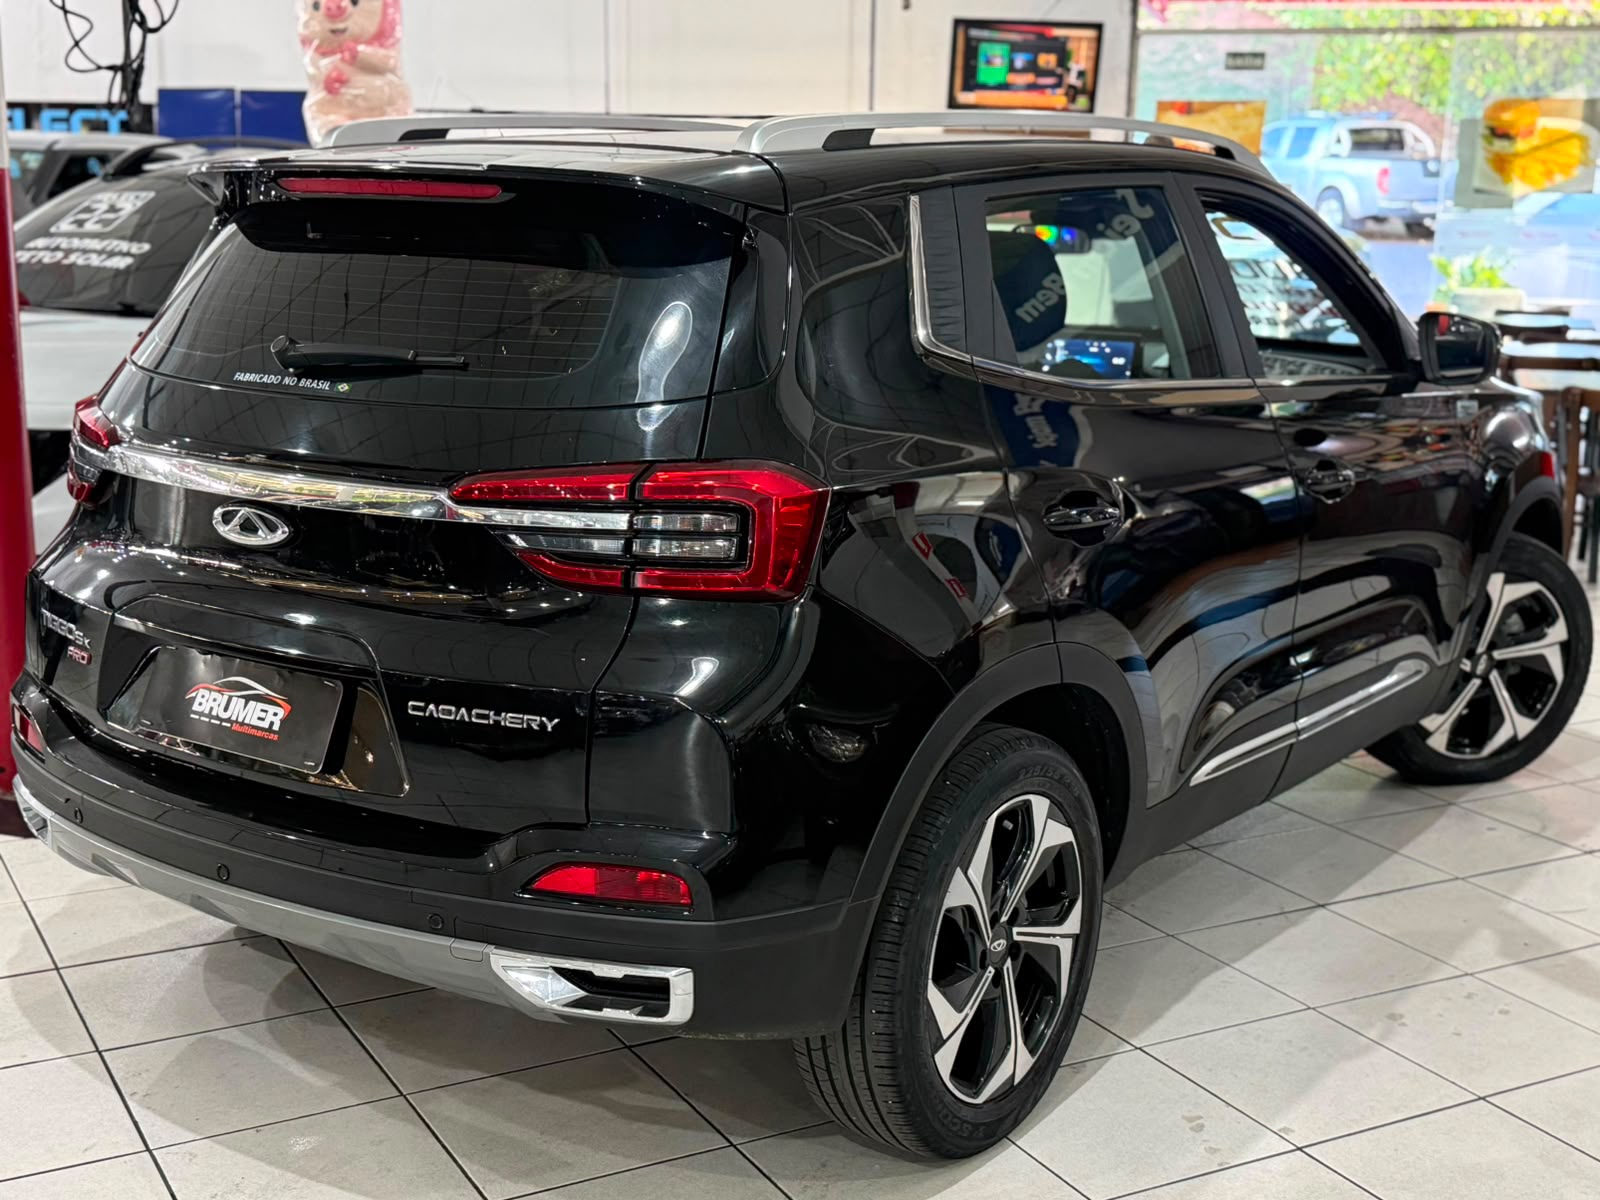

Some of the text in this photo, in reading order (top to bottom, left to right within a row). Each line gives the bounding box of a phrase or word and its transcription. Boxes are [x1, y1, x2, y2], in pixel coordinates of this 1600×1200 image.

[233, 372, 330, 390] FABRICADO NO BRASIL
[67, 645, 92, 665] PRO
[192, 688, 285, 731] BRUMER
[231, 722, 280, 741] Multimarcas
